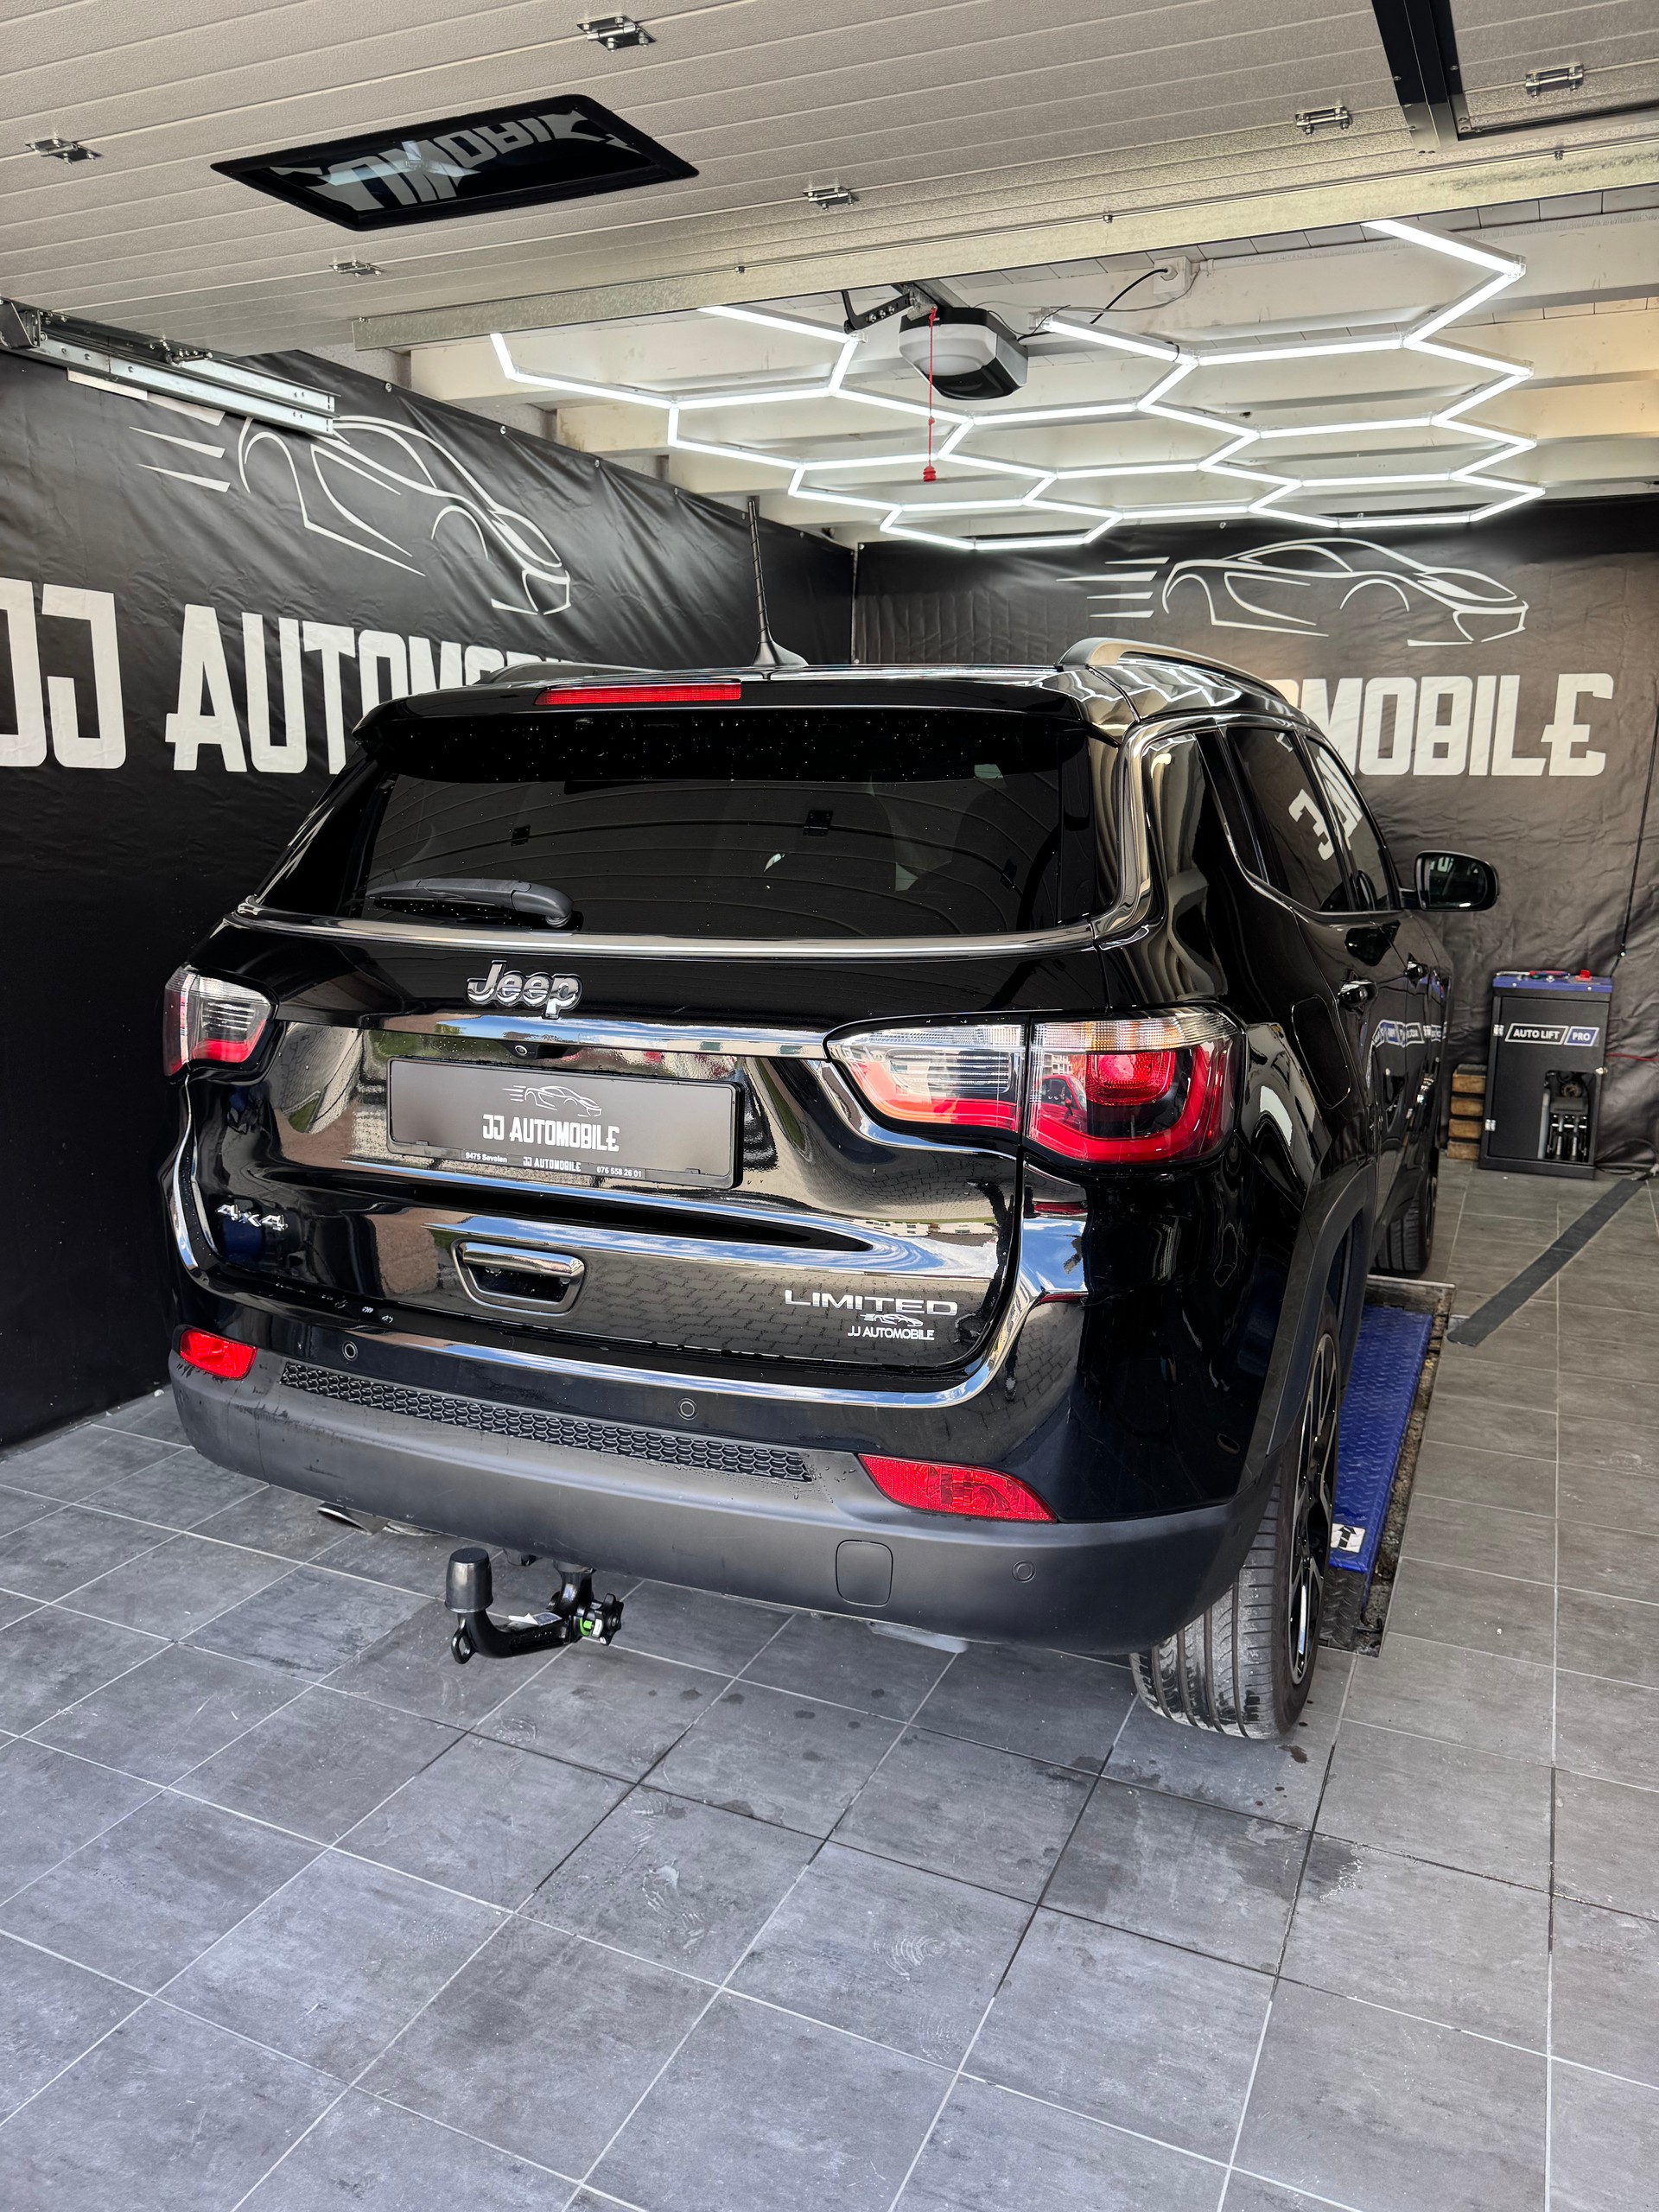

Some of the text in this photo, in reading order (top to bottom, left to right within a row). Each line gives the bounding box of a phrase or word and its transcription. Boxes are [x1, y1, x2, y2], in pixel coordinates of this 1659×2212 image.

[1266, 673, 1613, 777] MOBILE
[466, 959, 583, 1020] Jeep
[1513, 1028, 1592, 1041] AUTO LIFT PRO
[482, 1114, 620, 1153] JJ AUTOMOBILE
[465, 1152, 508, 1164] 9475 Sevelen
[523, 1156, 582, 1173] JJ AUTOMOBILE
[596, 1166, 609, 1175] 076
[610, 1167, 623, 1176] 558
[784, 1289, 958, 1316] LIMITED
[847, 1325, 935, 1341] JJ AUTOMOBILE
